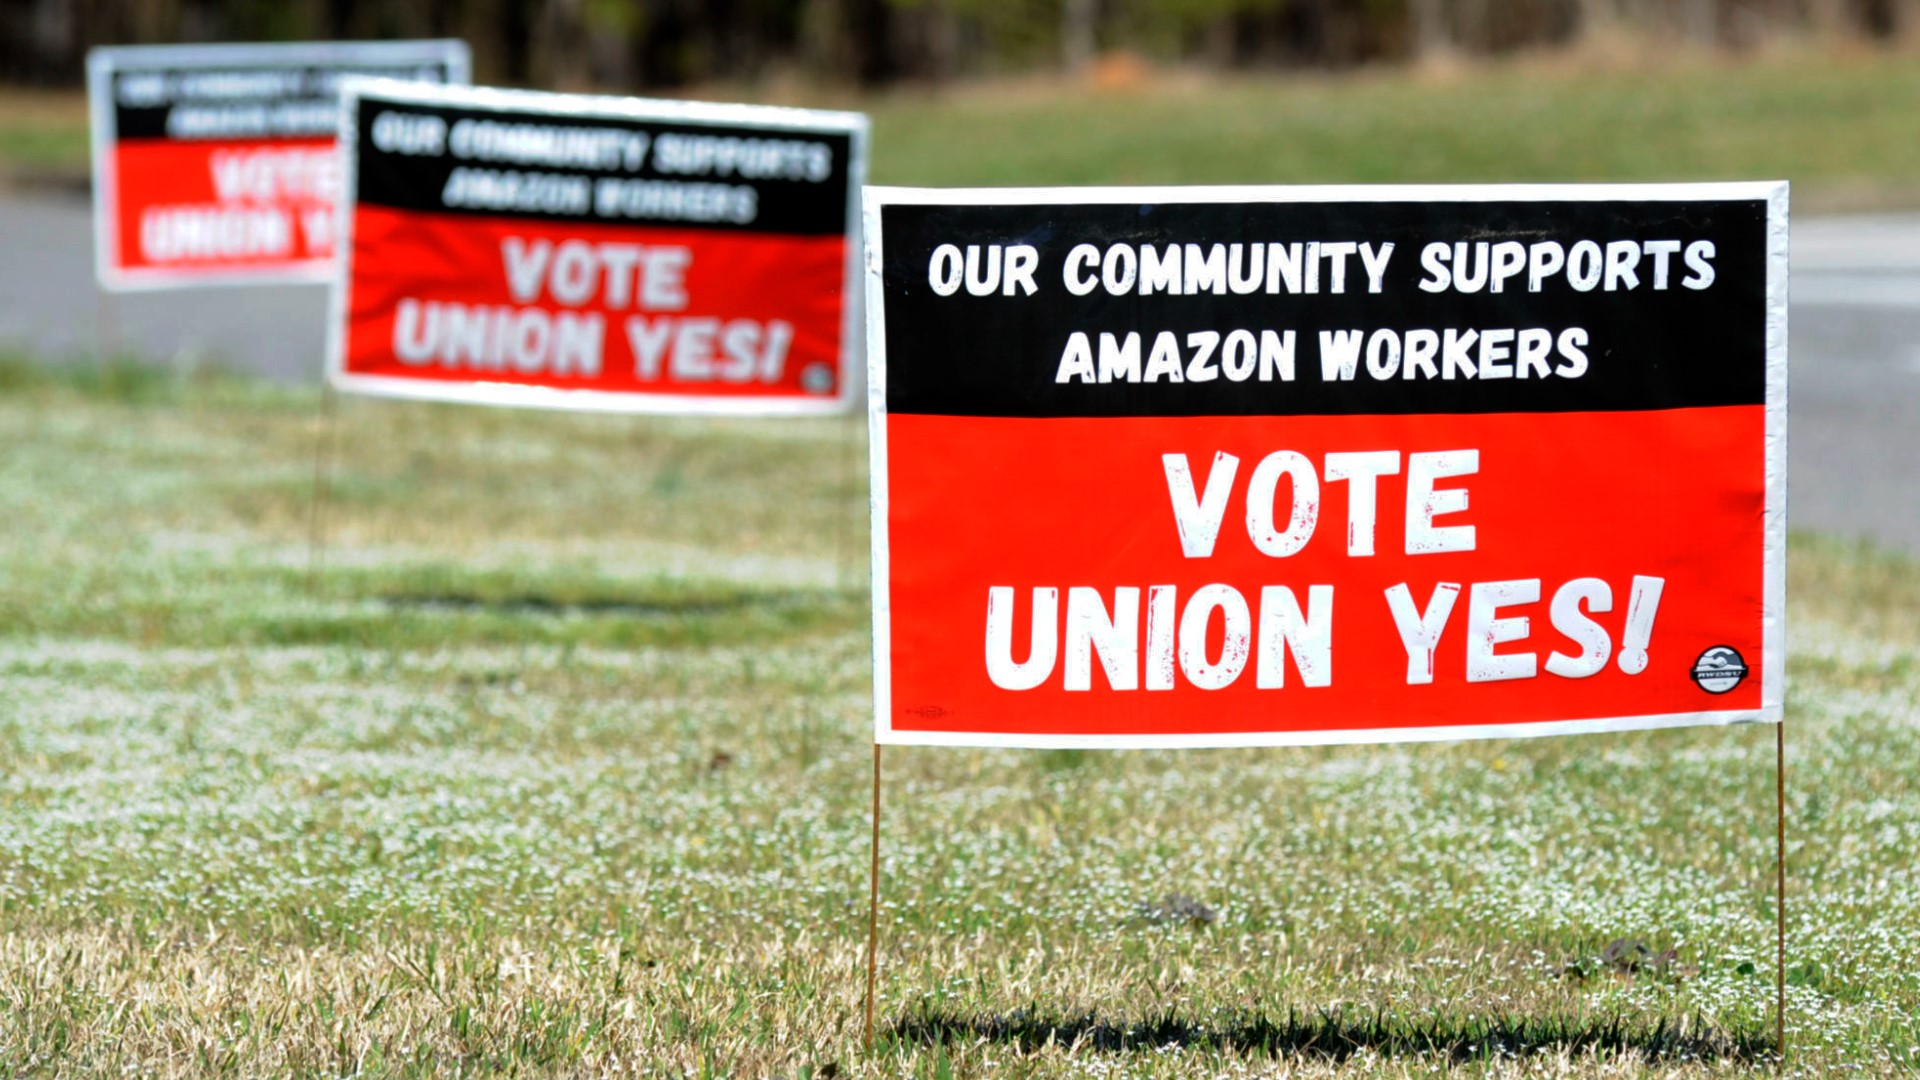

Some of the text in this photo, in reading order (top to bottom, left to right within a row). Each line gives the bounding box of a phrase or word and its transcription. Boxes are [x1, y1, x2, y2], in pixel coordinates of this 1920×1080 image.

[371, 111, 447, 157] OUR
[449, 119, 650, 171] COMMUNITY
[653, 133, 832, 182] SUPPORTS
[503, 237, 691, 310] VOTE
[927, 239, 1716, 297] OUR COMMUNITY SUPPORTS
[392, 298, 794, 383] UNION YES!
[1055, 327, 1589, 384] AMAZON WORKERS
[1161, 448, 1480, 559] VOTE
[985, 574, 1666, 693] UNION YES!
